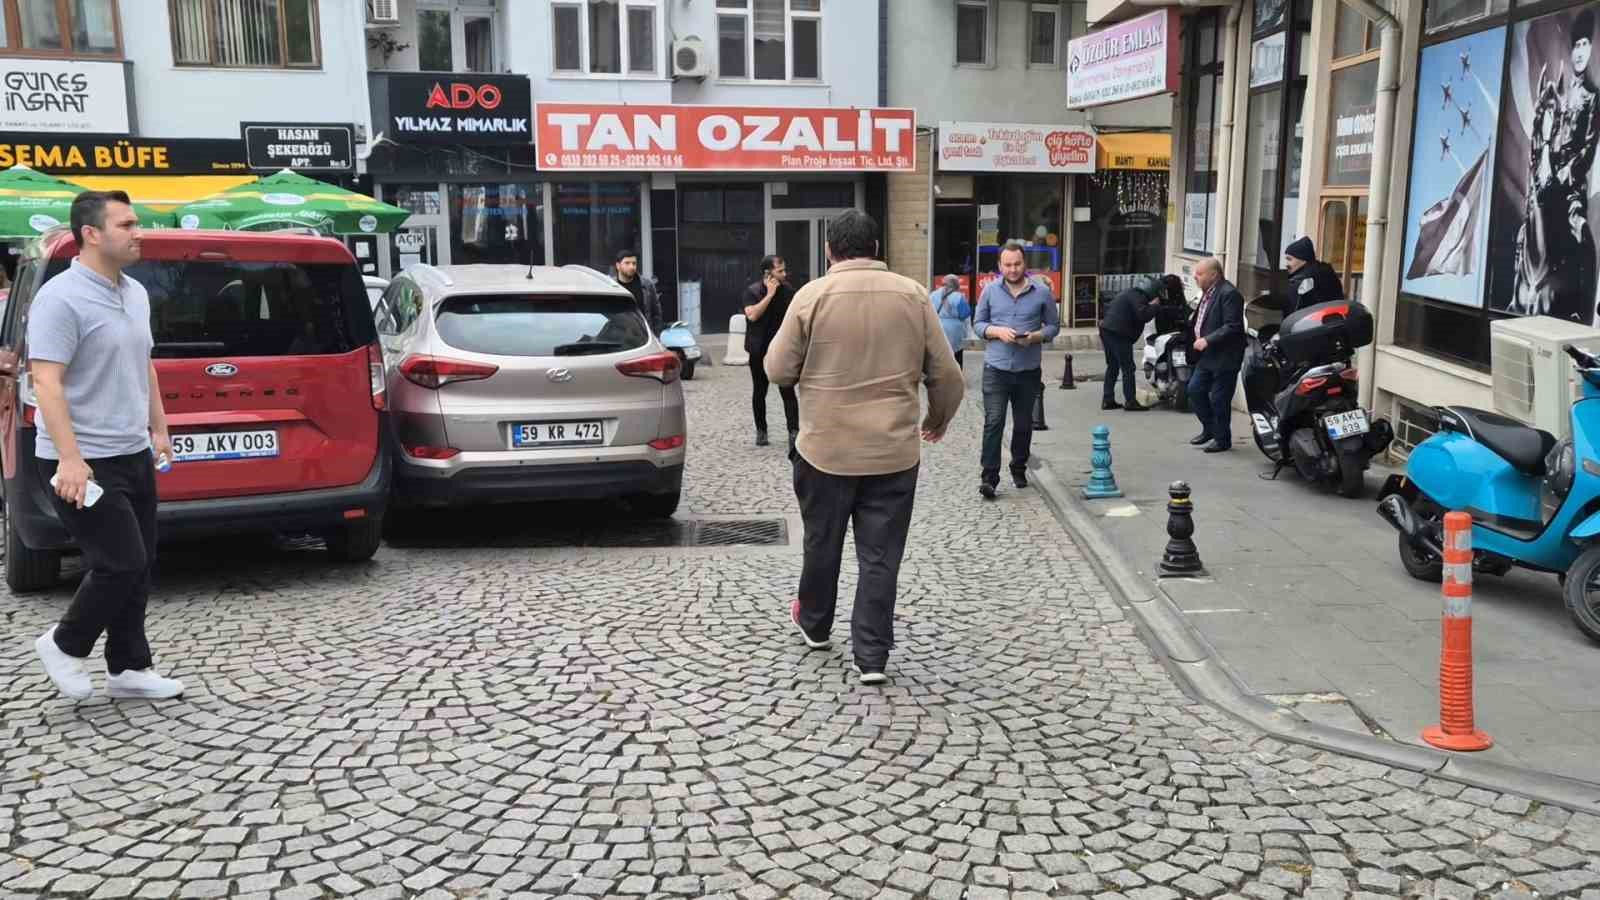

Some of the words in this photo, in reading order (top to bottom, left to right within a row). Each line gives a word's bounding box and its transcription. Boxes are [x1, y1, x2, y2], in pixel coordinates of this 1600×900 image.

[1123, 24, 1163, 54] EMLAK
[425, 81, 503, 110] ADO
[394, 116, 452, 132] YILMAZ
[547, 113, 677, 152] TAN
[697, 109, 912, 153] OZALİT
[277, 129, 319, 141] HASAN
[0, 144, 87, 168] SEMA
[94, 140, 170, 169] BÜFE
[267, 142, 332, 158] ŞEKERÖZÜ
[291, 158, 312, 167] APT.
[781, 155, 801, 167] Plan
[803, 155, 827, 169] Proje
[860, 155, 875, 167] Tic.
[397, 232, 425, 246] AÇIK
[1342, 409, 1364, 423] AKL
[521, 426, 538, 441] 59
[548, 425, 565, 440] KR
[575, 423, 600, 438] 472
[173, 437, 194, 453] 59
[206, 435, 237, 452] AKV
[243, 433, 275, 450] 003
